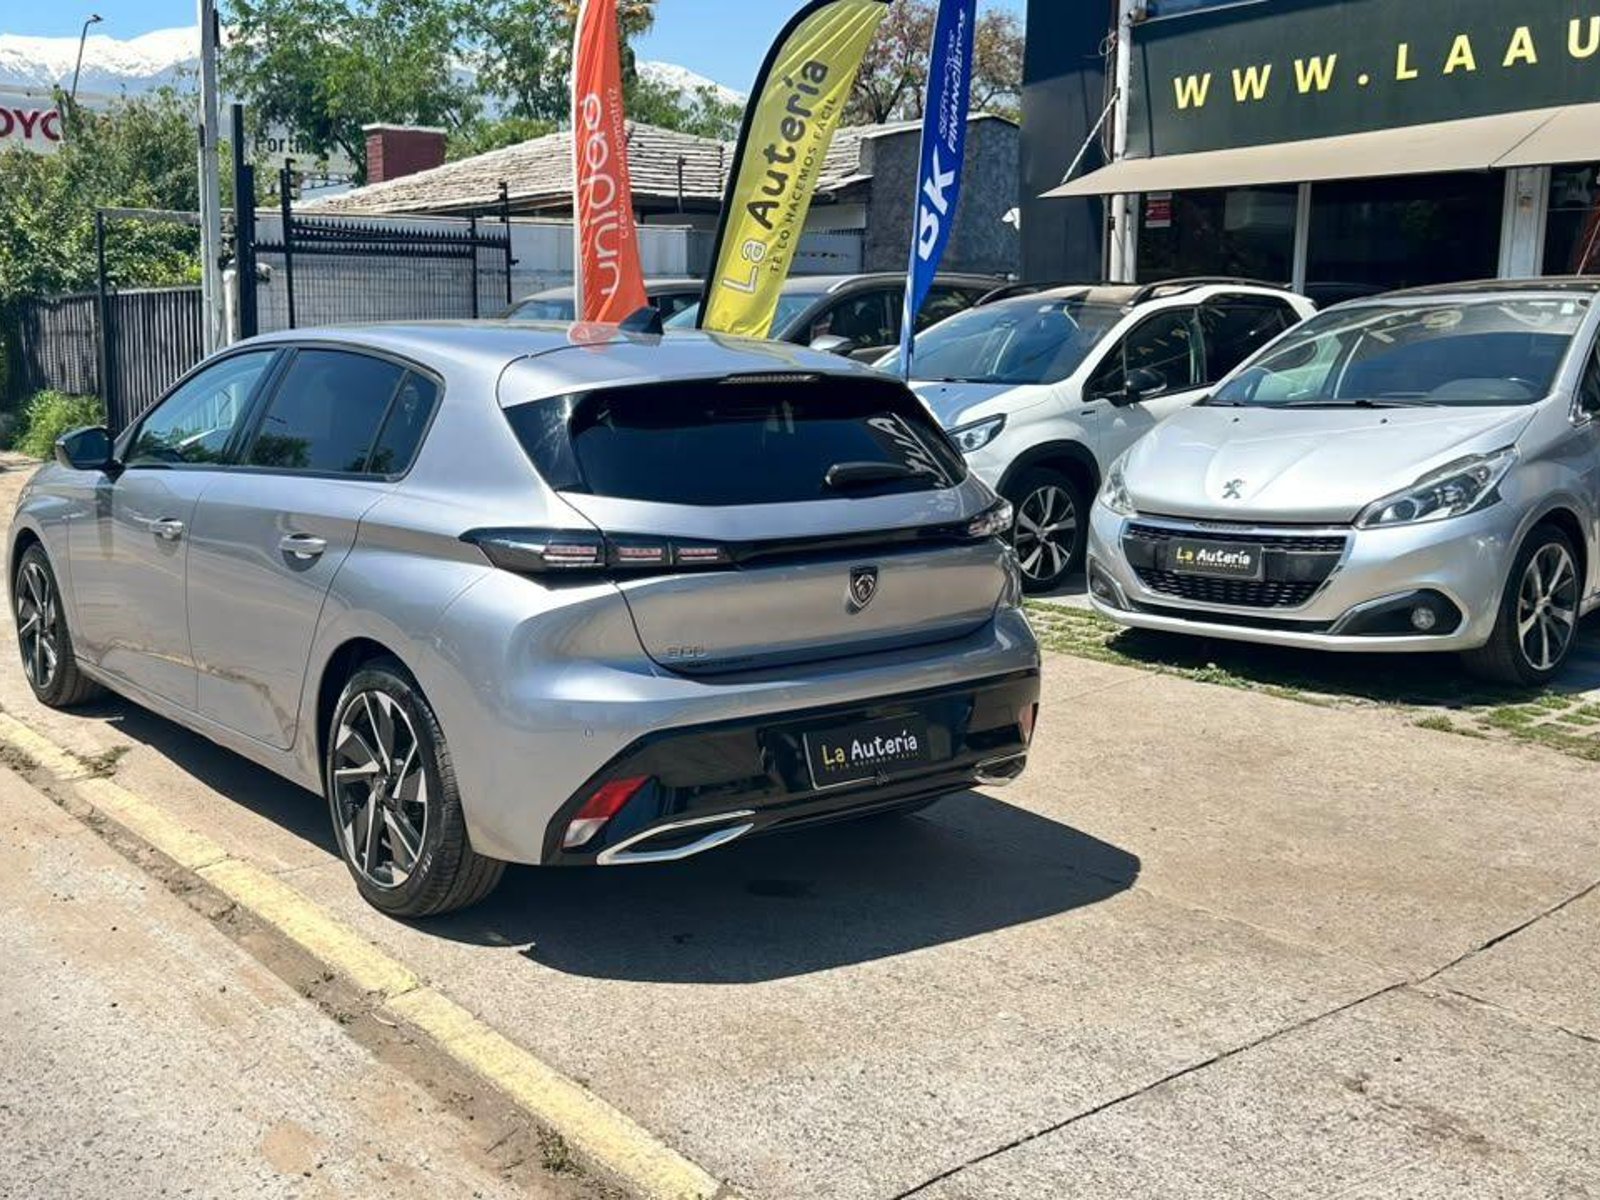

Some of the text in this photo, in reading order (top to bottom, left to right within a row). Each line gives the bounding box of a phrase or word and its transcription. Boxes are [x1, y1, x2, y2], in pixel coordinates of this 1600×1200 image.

[722, 59, 829, 294] La Autería
[779, 229, 790, 249] LO
[786, 147, 817, 224] HACEMOS
[1176, 547, 1194, 561] La
[822, 744, 846, 765] La
[851, 730, 918, 760] Autería
